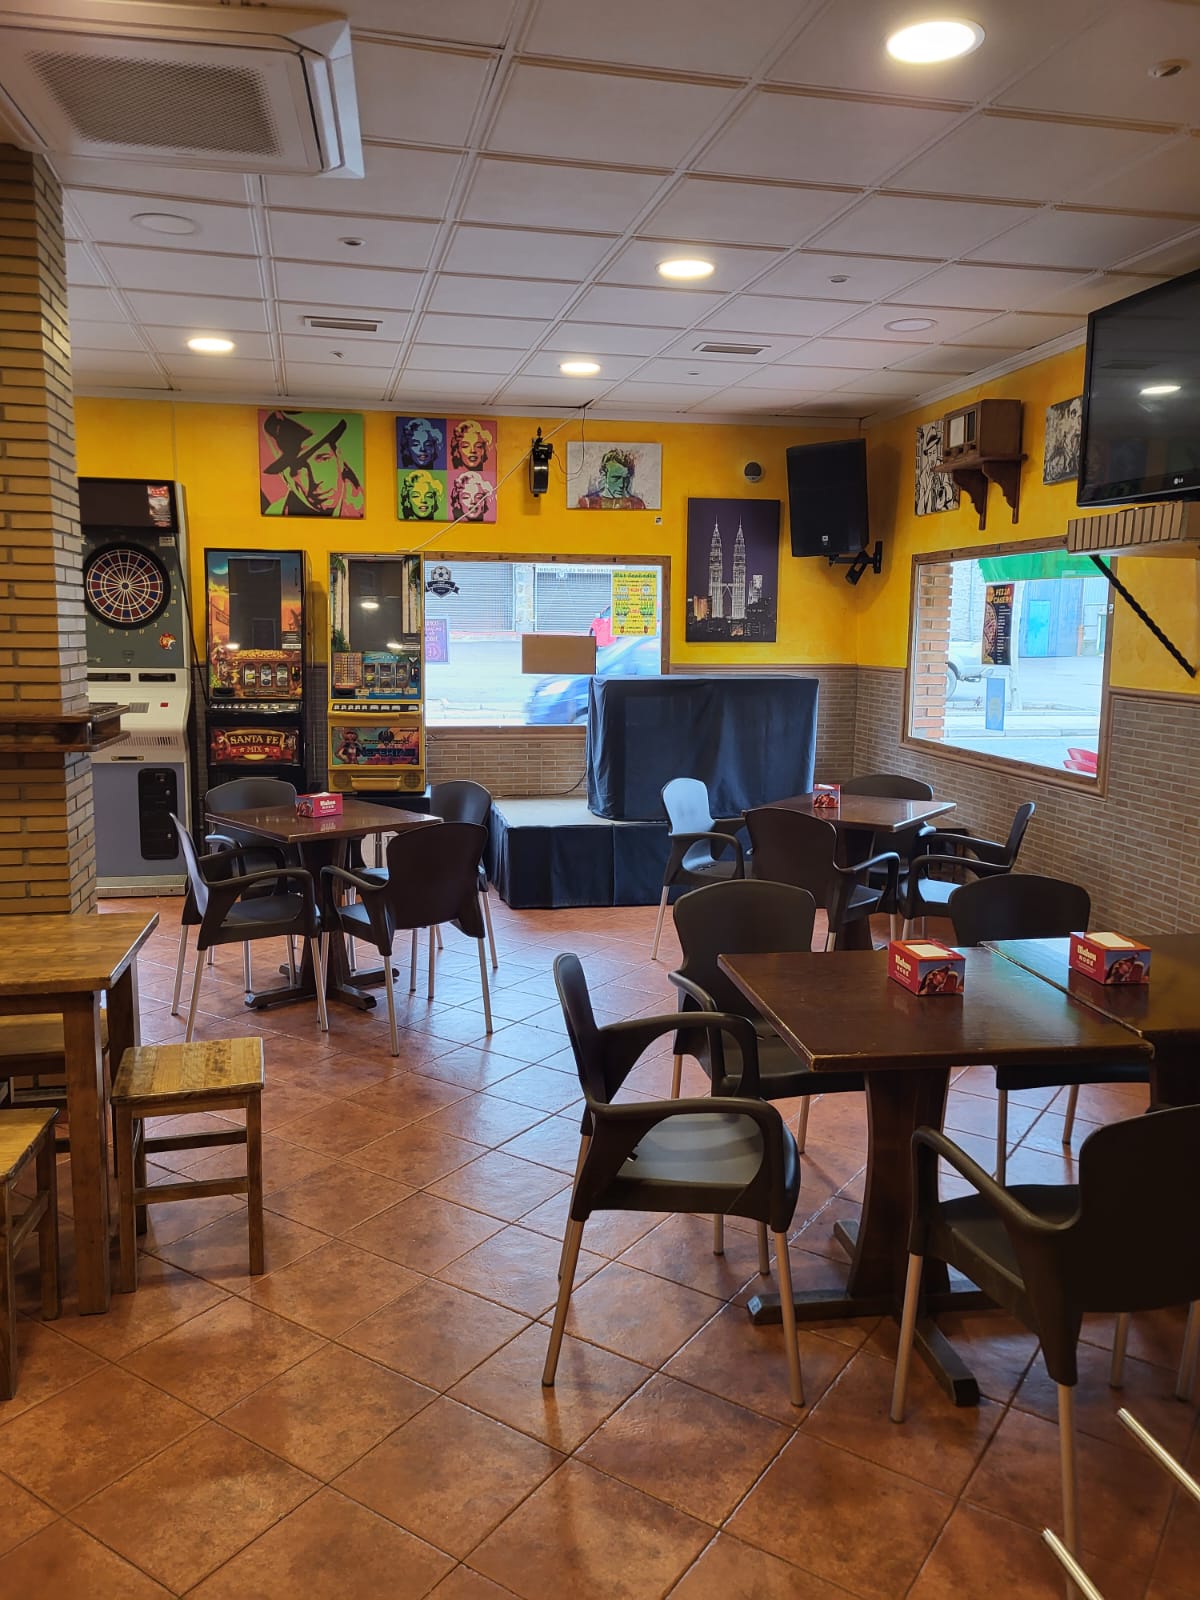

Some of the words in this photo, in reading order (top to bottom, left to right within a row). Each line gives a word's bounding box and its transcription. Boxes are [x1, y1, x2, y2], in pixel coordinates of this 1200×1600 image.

[230, 735, 264, 745] SANTA
[266, 735, 280, 745] FE
[246, 745, 262, 753] MIX
